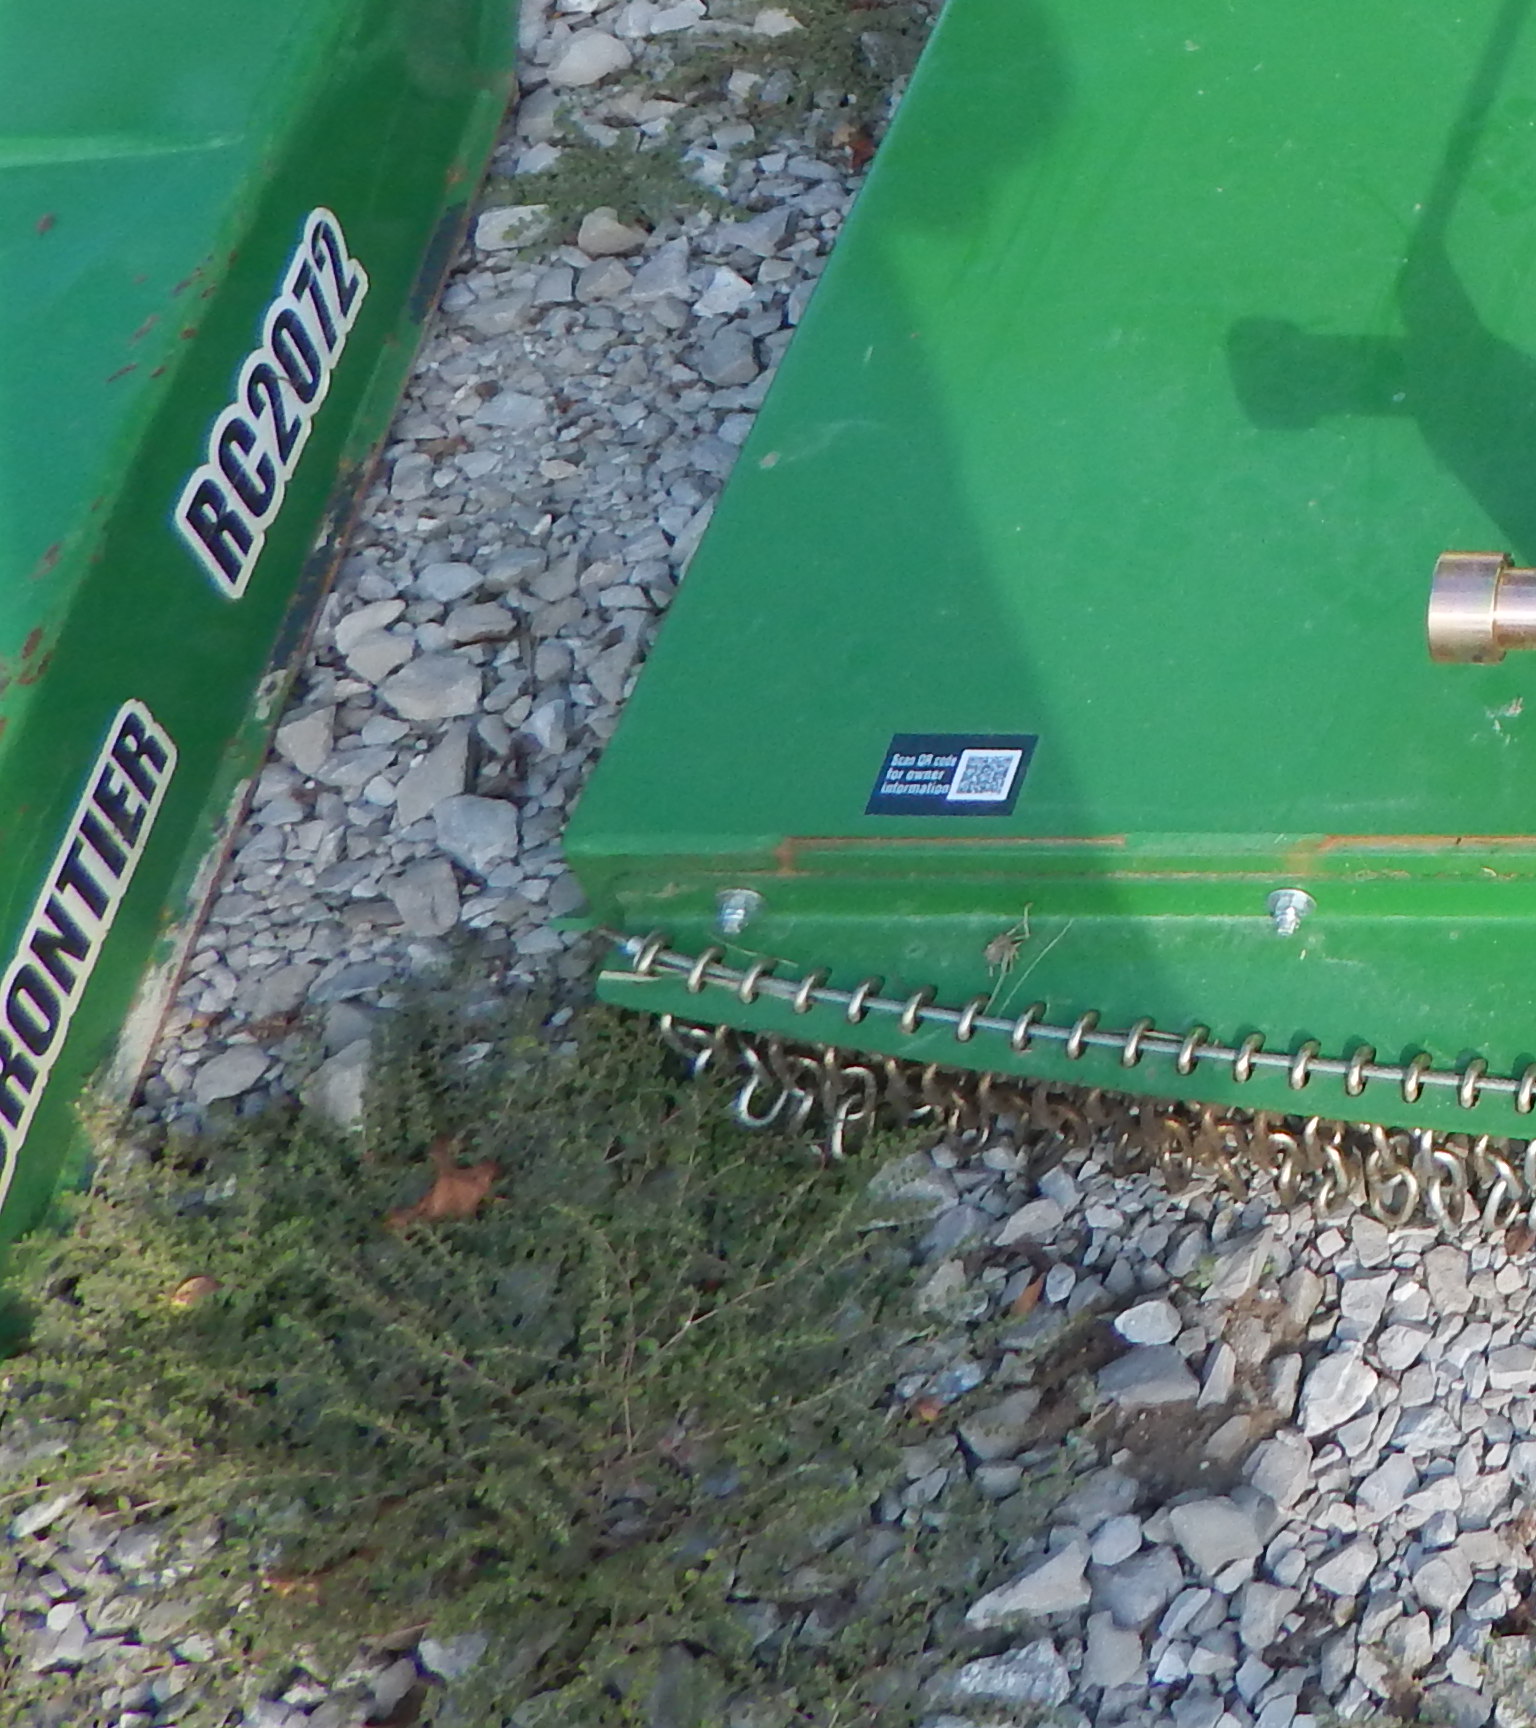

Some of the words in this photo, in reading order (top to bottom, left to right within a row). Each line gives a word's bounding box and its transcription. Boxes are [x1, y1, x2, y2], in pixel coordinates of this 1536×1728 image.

[182, 216, 363, 589] RC2072
[887, 768, 904, 780] for
[906, 770, 945, 780] owner
[891, 753, 916, 766] Scan
[917, 753, 933, 767] QR
[934, 754, 957, 767] code
[0, 710, 169, 1179] RONTIER
